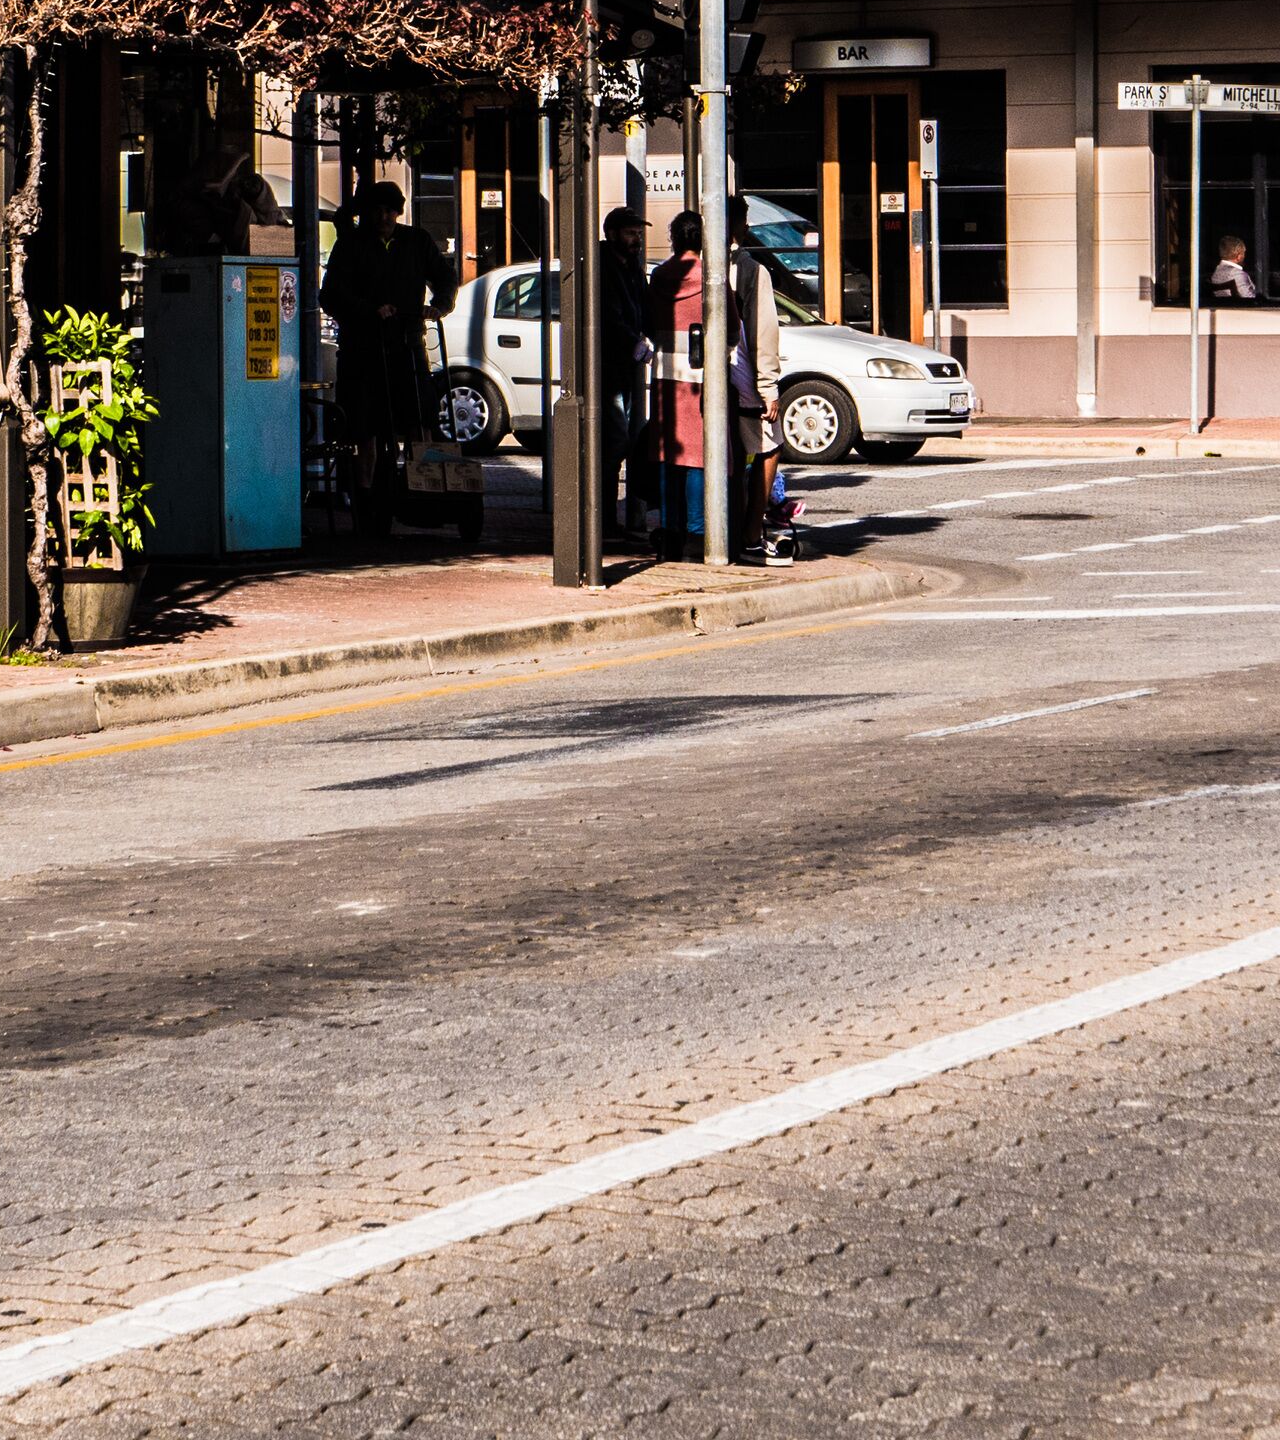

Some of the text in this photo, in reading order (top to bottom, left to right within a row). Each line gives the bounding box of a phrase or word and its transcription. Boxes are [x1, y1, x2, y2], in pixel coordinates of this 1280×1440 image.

[837, 46, 869, 62] BAR
[1124, 85, 1153, 100] PARK
[1223, 86, 1280, 104] MITCHELL
[1267, 102, 1280, 111] 1-71
[645, 183, 682, 192] ELLAR
[254, 310, 271, 323] 1800
